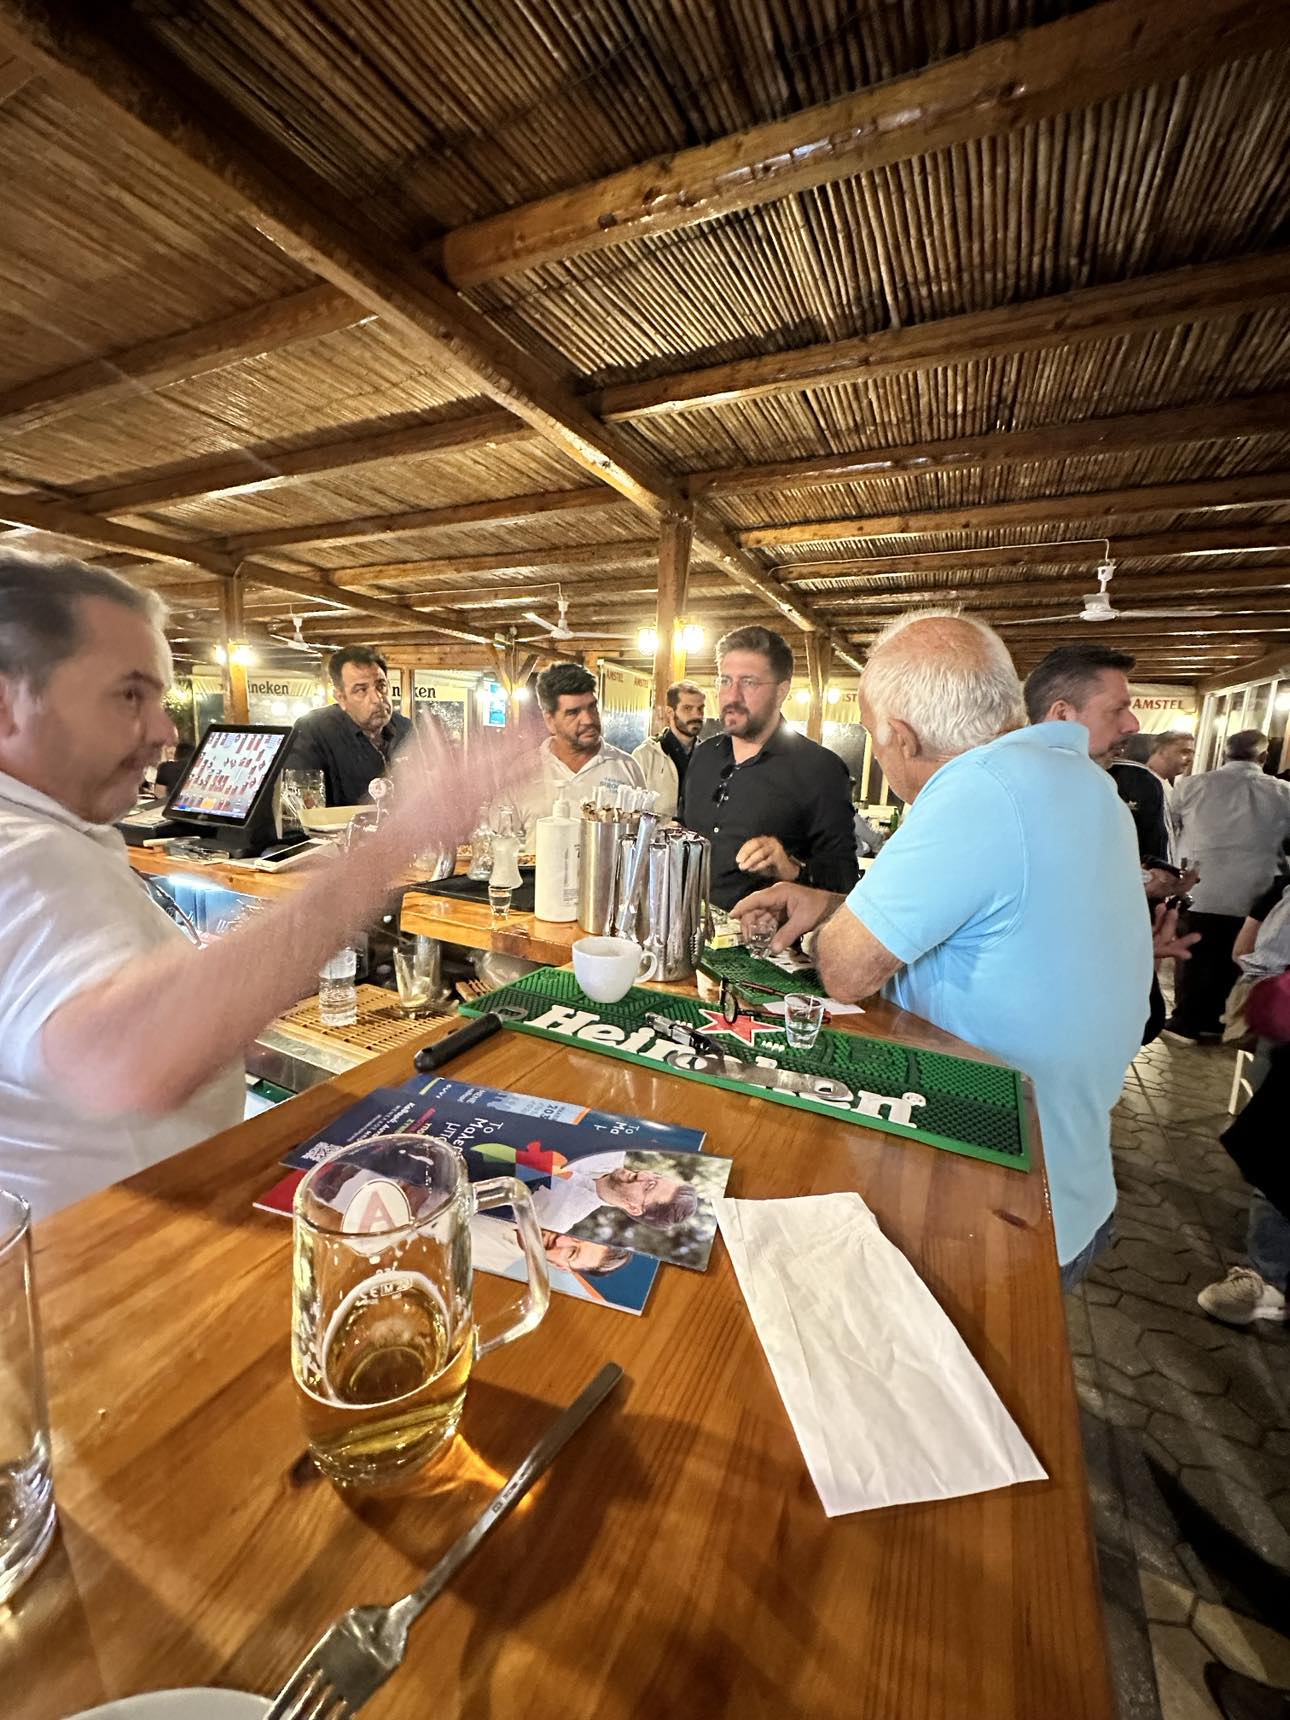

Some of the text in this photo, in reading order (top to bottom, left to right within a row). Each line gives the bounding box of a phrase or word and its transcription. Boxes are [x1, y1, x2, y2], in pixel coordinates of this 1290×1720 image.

[248, 680, 289, 695] ineken
[1133, 699, 1185, 710] AMSTEL
[524, 1005, 922, 1128] Heinn
[483, 1122, 504, 1134] Το
[610, 1121, 628, 1135] Μα
